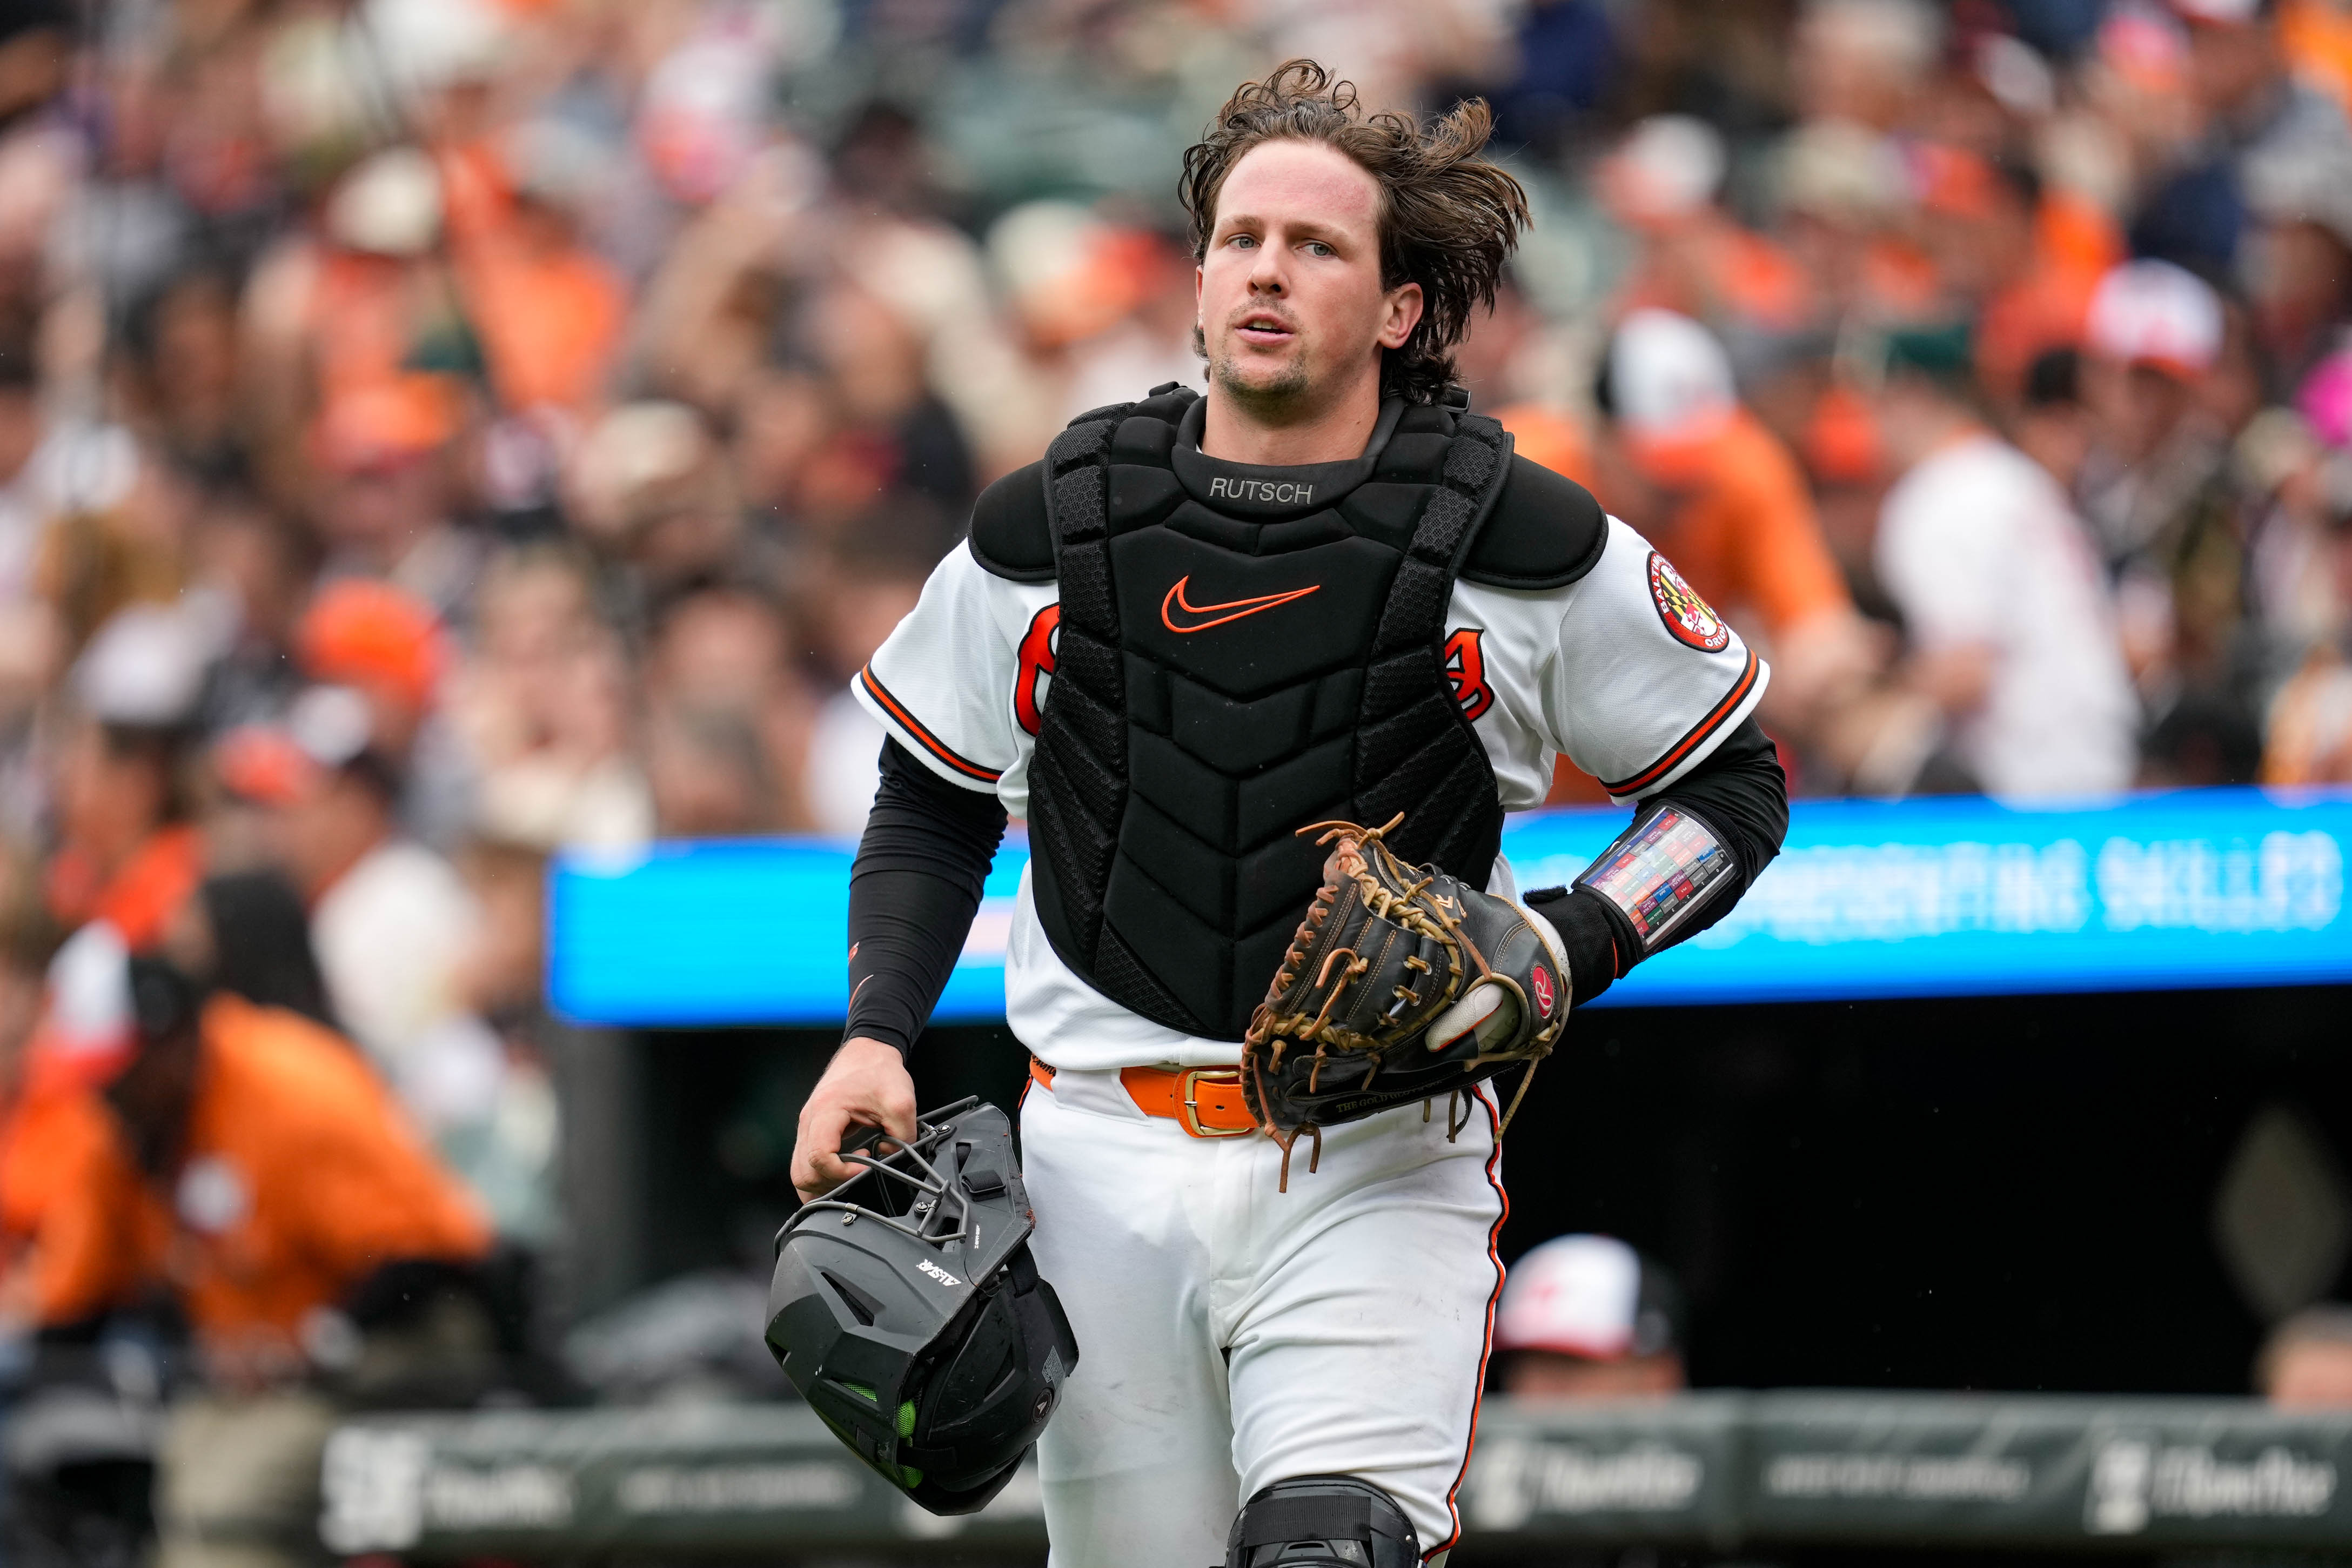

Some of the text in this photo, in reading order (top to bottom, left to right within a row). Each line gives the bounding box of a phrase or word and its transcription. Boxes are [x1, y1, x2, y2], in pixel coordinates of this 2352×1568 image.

[1209, 478, 1312, 504] RUTSCH
[1336, 1095, 1388, 1113] THE GOLD
[919, 1258, 961, 1286] ALL-STAR
